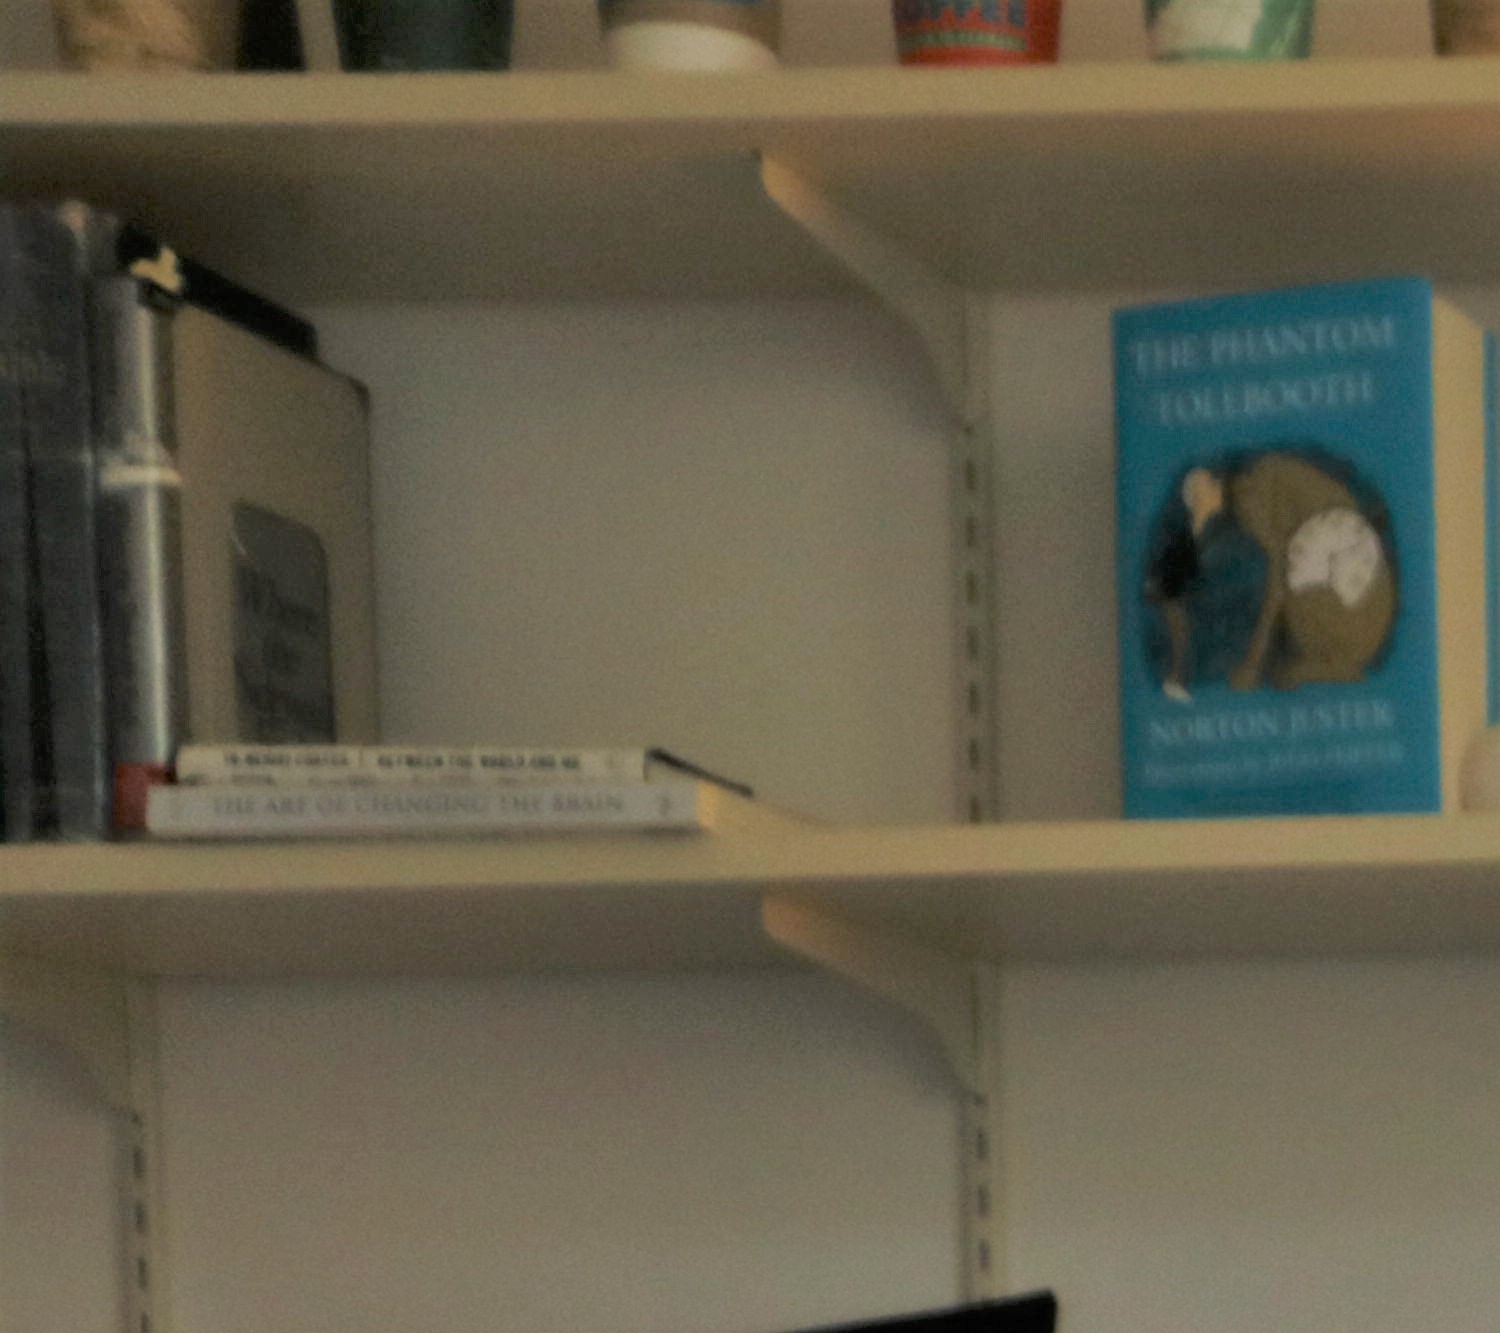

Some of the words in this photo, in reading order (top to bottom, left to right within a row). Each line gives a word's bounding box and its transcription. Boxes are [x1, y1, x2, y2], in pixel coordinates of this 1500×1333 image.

[1136, 334, 1199, 377] THE
[1209, 315, 1397, 367] PHANTOM
[1158, 369, 1376, 427] TOLLBOOTH
[1149, 712, 1279, 748] NORTON
[1289, 697, 1395, 734] JUSTER
[214, 795, 257, 816] THE
[265, 795, 306, 815] ART
[316, 795, 348, 815] OF
[354, 793, 492, 814] CHANGING
[551, 791, 626, 813] BRAIN
